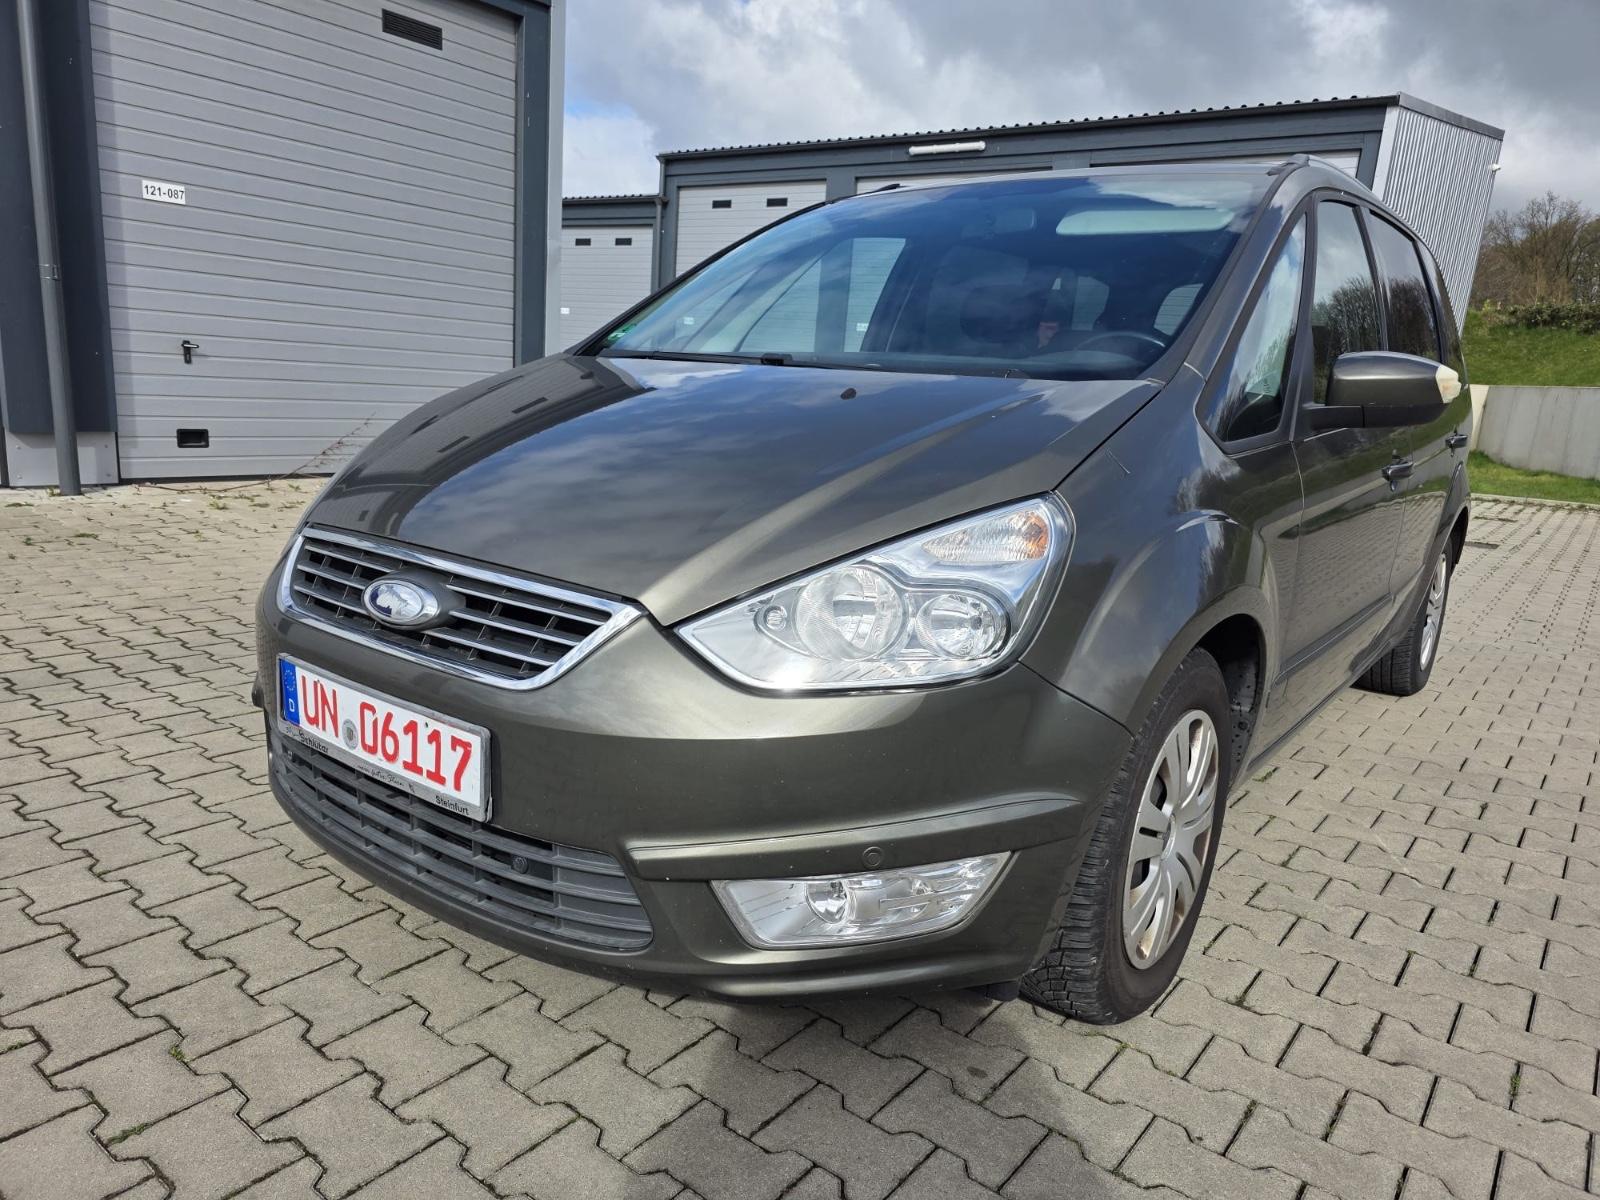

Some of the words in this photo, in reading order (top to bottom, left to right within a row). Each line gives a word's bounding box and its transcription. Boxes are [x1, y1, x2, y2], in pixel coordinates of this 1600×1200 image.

[144, 185, 185, 200] 121-087
[288, 698, 295, 712] D
[301, 675, 339, 738] UN
[359, 701, 473, 792] 06117
[435, 795, 470, 815] Steinfurt
